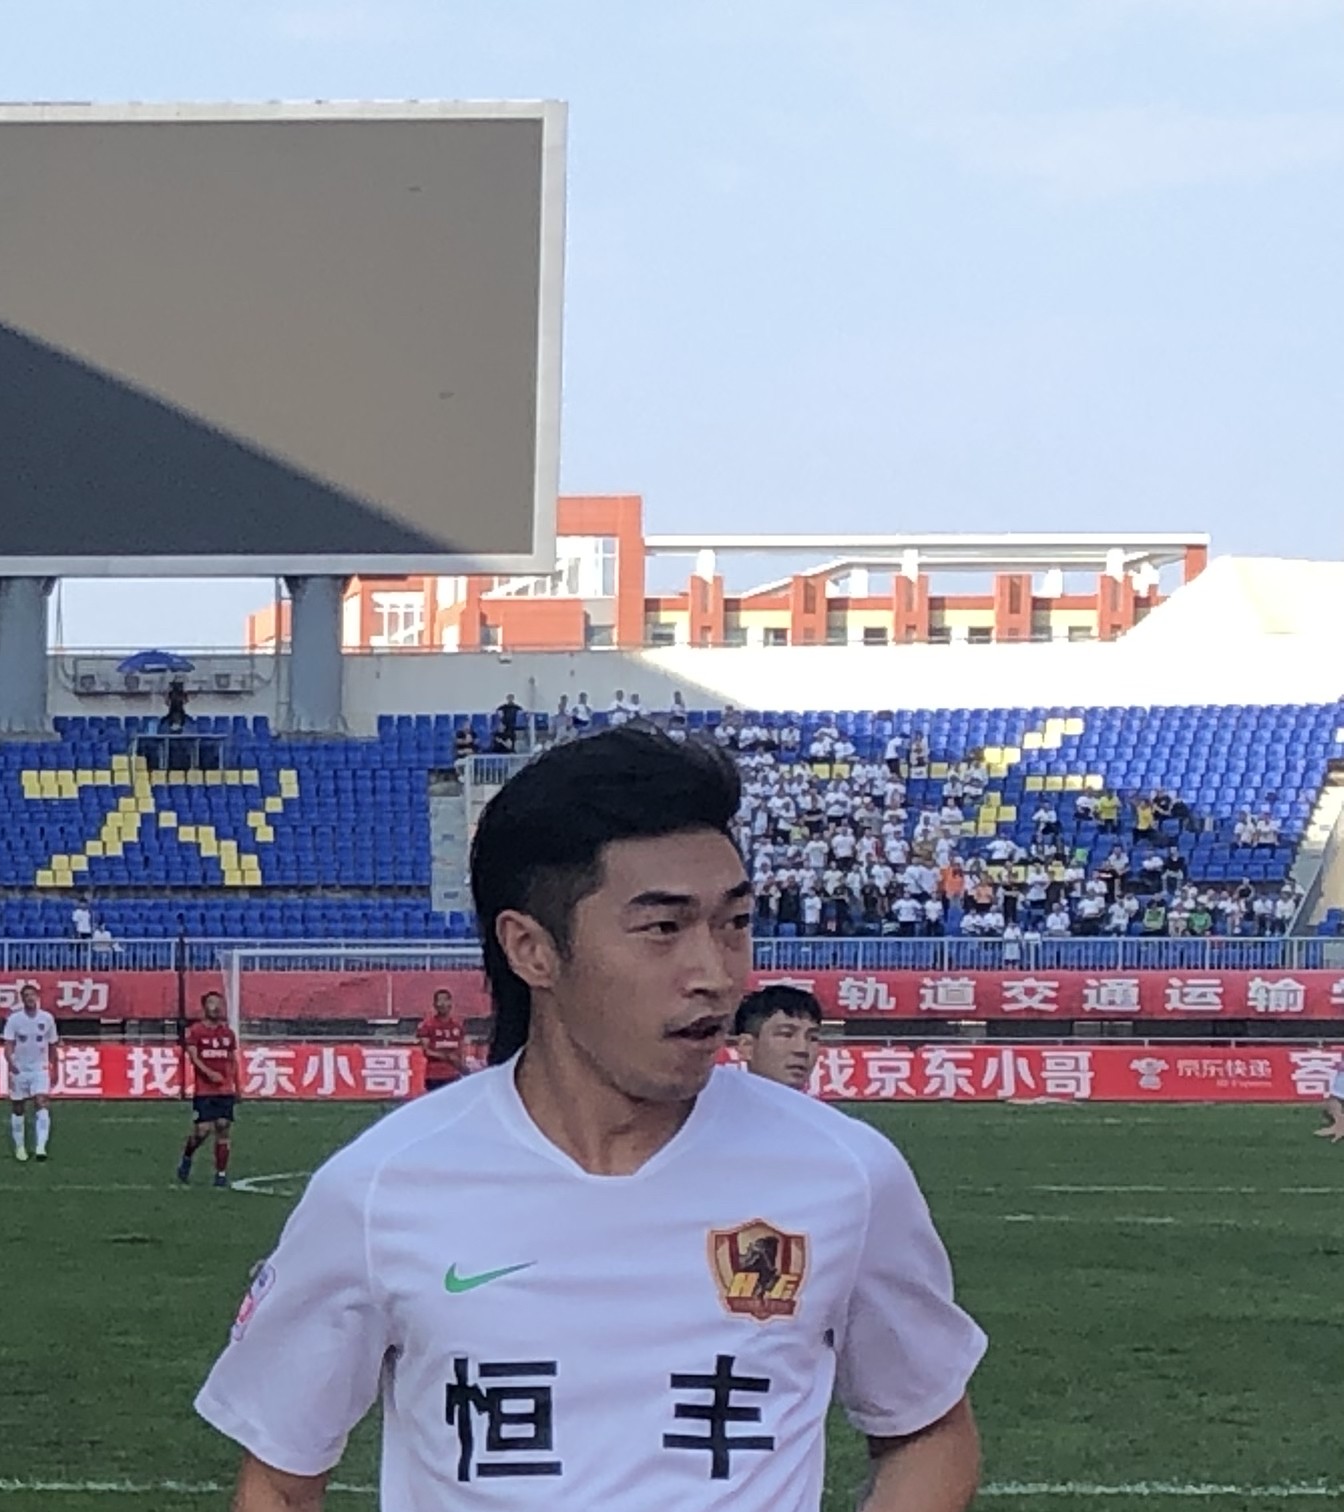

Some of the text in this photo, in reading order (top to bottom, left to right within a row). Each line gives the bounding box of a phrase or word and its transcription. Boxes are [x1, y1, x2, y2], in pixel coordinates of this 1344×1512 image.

[759, 976, 1344, 1012] 轨道交通运输
